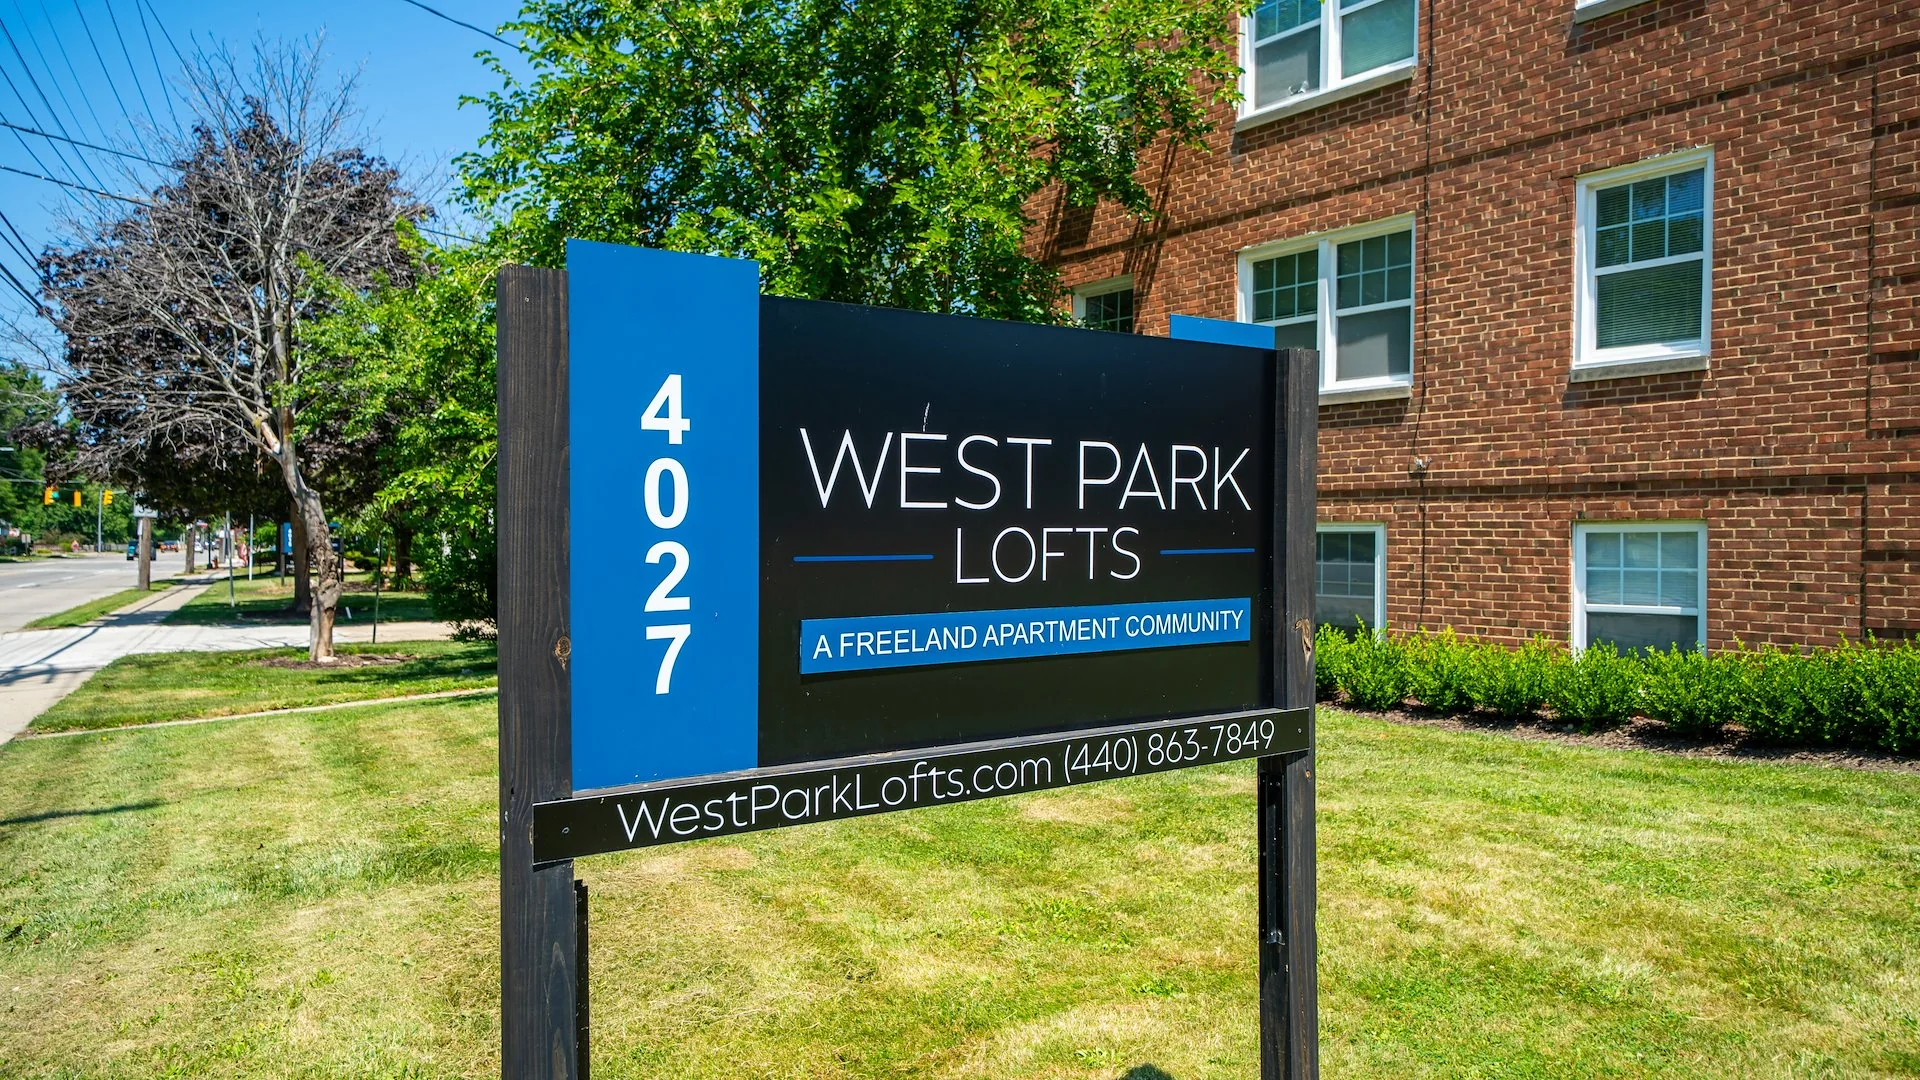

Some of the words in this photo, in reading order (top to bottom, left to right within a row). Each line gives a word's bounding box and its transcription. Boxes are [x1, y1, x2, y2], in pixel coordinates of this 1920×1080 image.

[799, 427, 1052, 510] WEST
[1078, 440, 1252, 511] PARK
[640, 374, 691, 695] 4027
[956, 526, 1141, 584] LOFTS
[812, 634, 833, 660] A
[840, 625, 977, 657] FREELAND
[982, 616, 1120, 647] APARTMENT
[1125, 609, 1244, 637] COMMUNITY
[616, 757, 1051, 843] WestParkLofts.com
[1063, 735, 1139, 784] (440)
[1147, 719, 1275, 766] 863-7849
